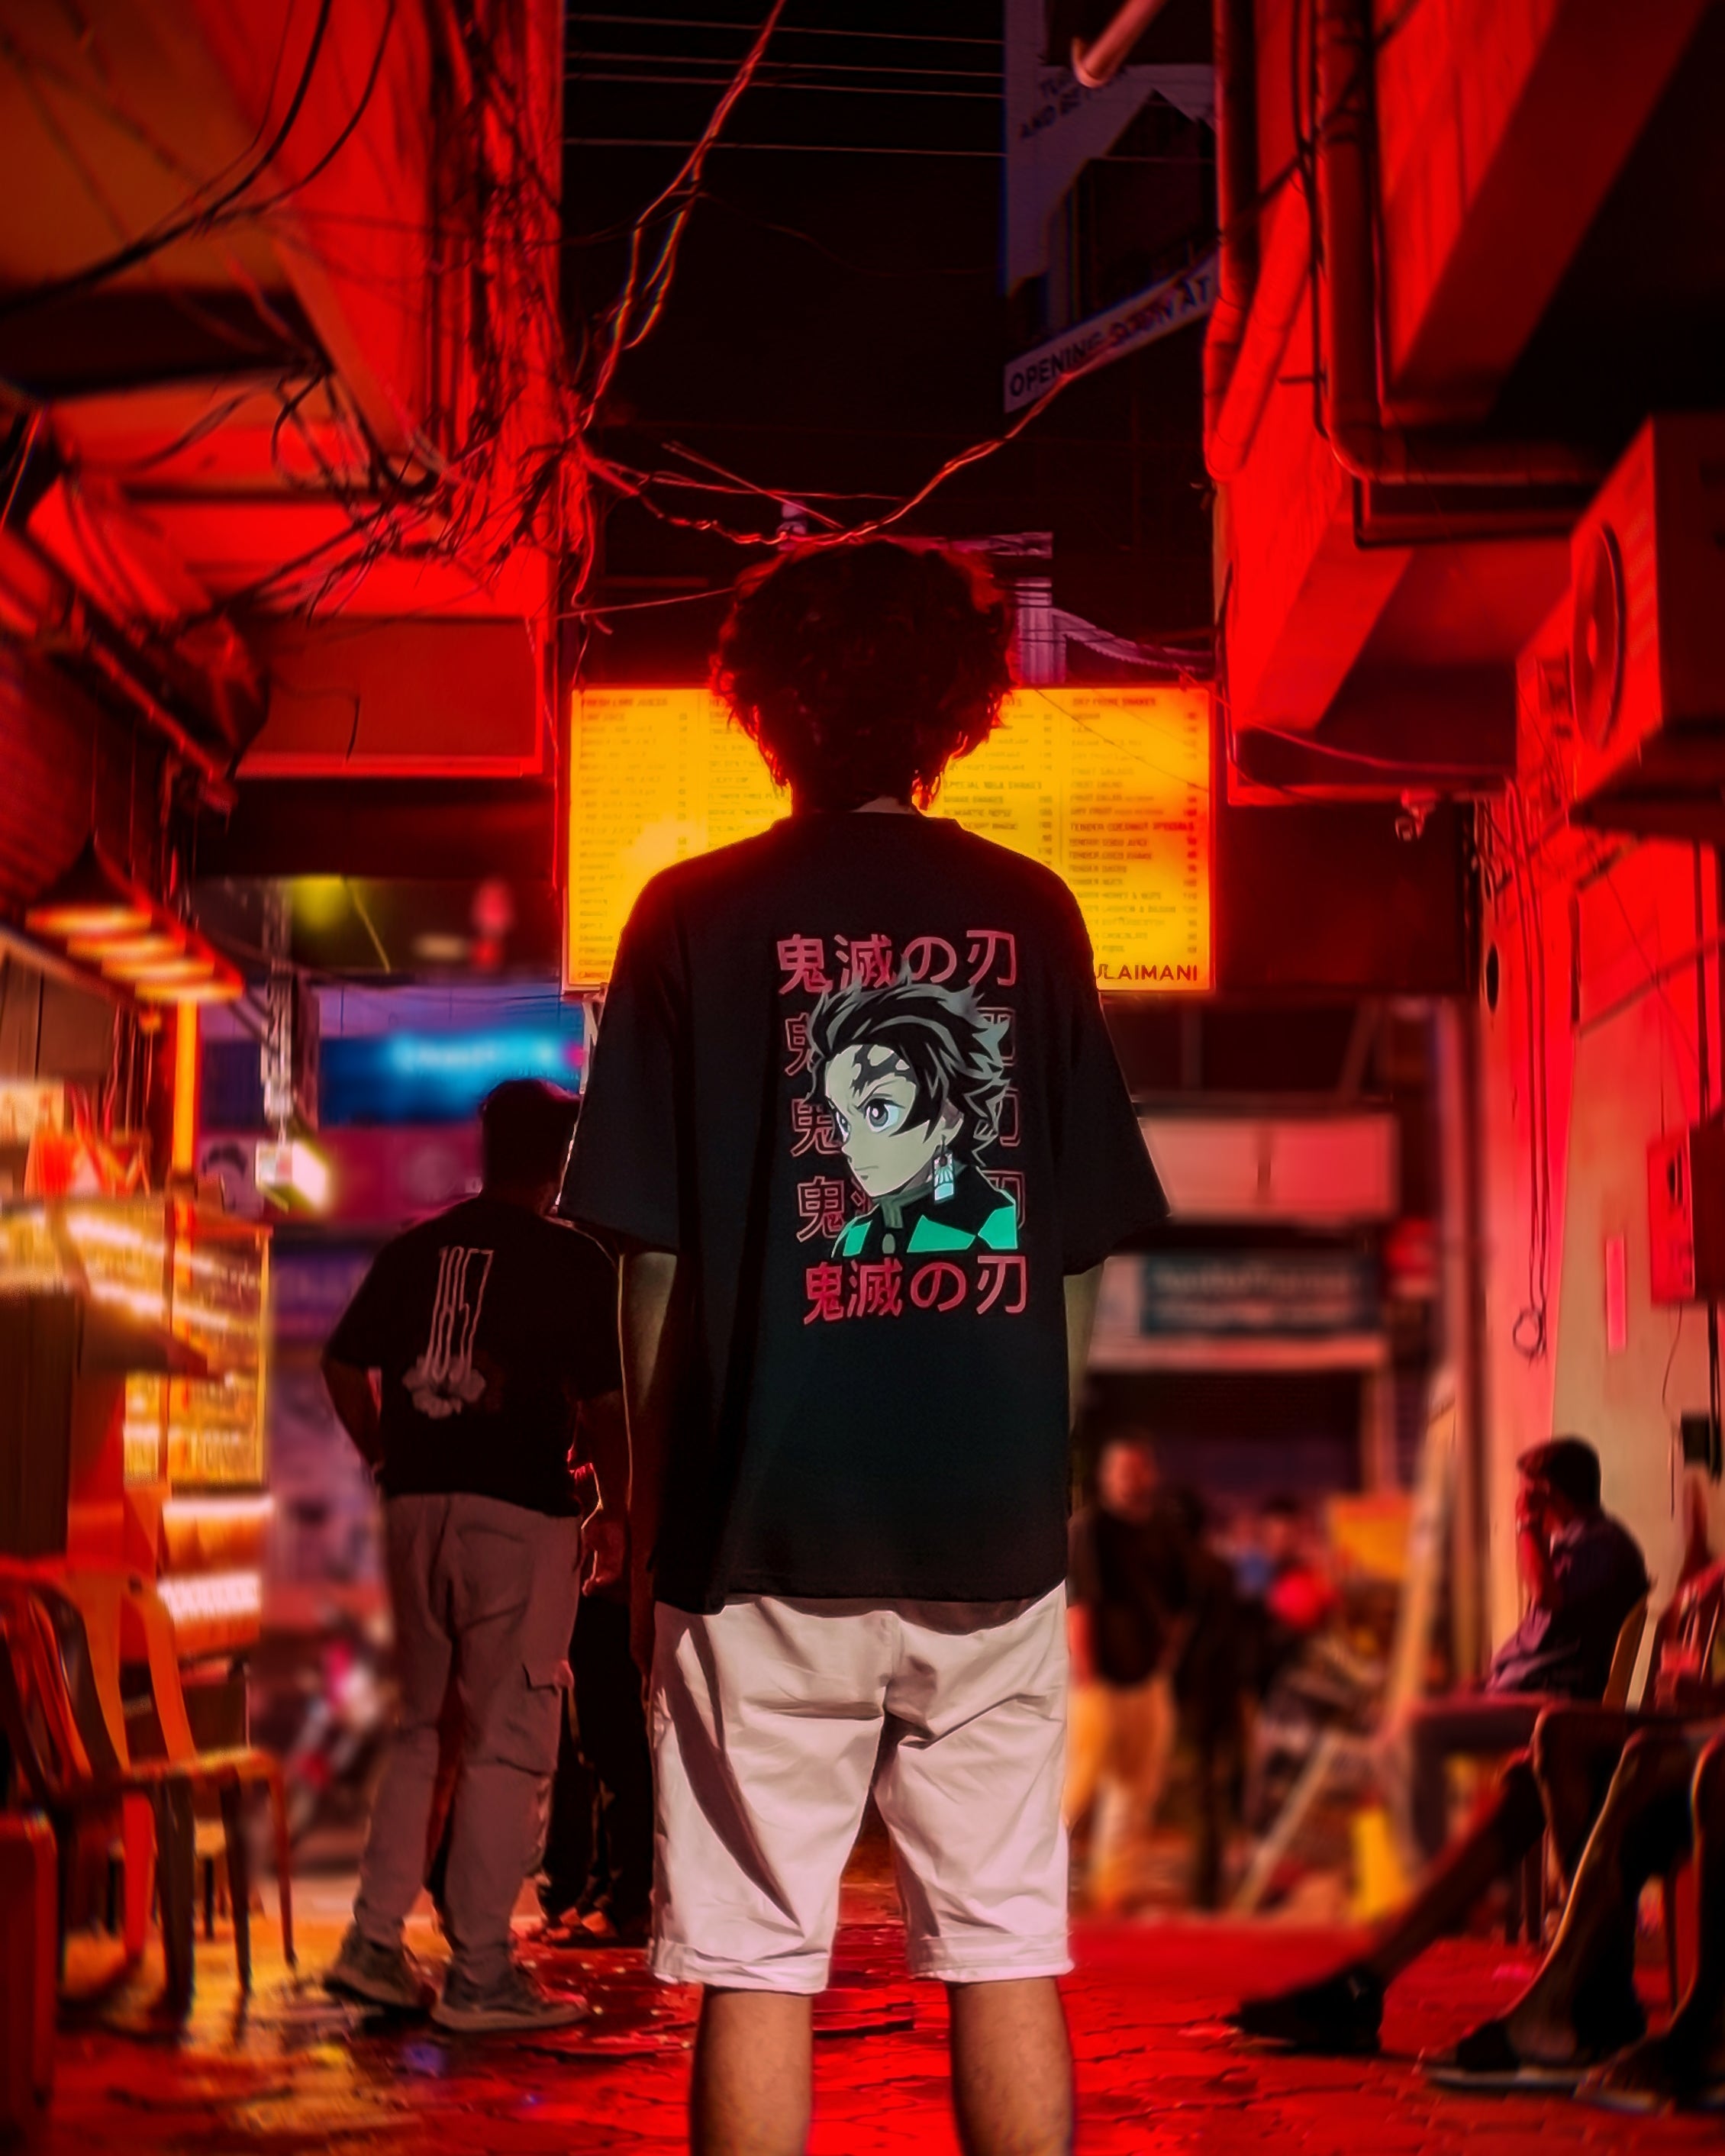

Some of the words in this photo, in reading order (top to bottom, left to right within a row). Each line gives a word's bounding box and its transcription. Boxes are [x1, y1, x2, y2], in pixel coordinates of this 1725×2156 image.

[777, 930, 1017, 994] 鬼滅の刃
[804, 1255, 1027, 1325] 鬼滅の刃
